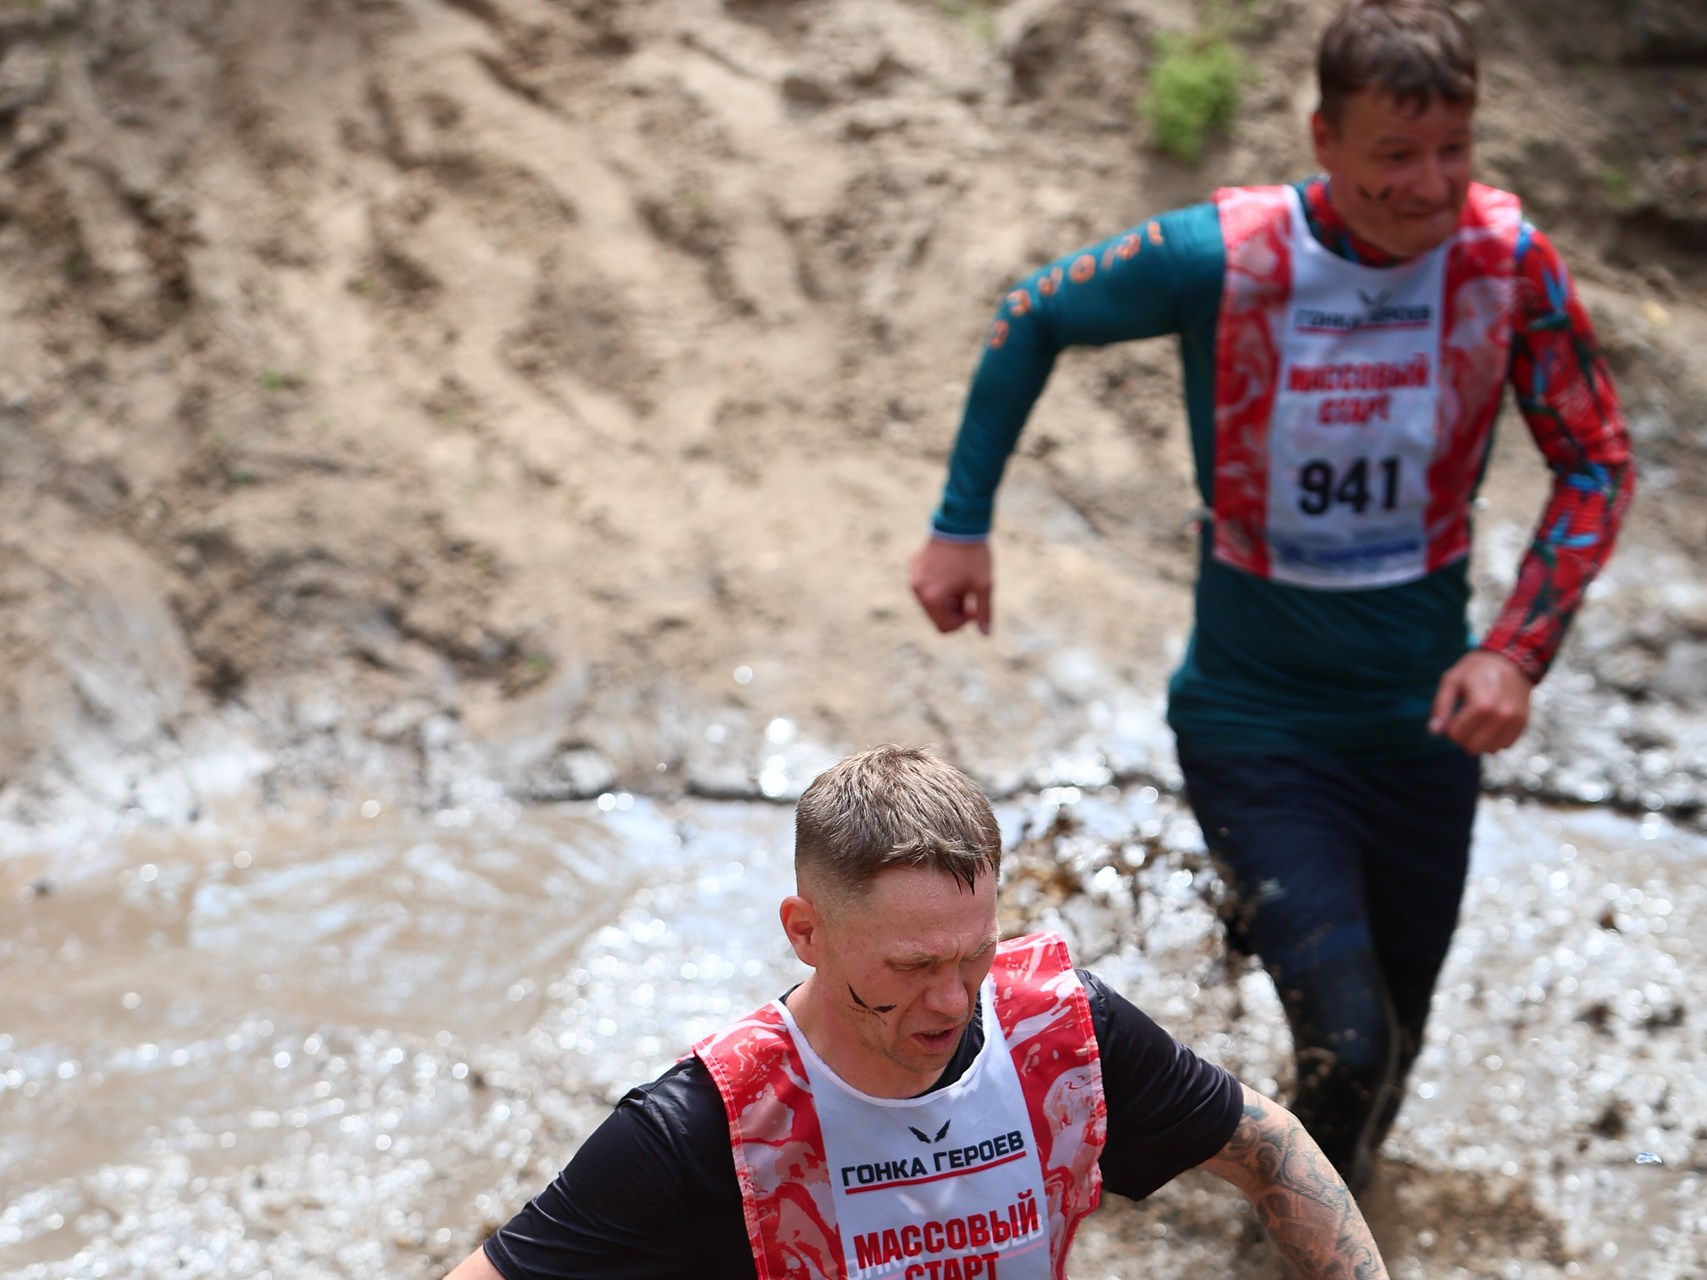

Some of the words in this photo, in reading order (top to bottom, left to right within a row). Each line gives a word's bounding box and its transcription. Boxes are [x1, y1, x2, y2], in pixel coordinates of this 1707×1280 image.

[1298, 455, 1401, 516] 941
[841, 1156, 928, 1187] ГОНКА
[932, 1130, 1025, 1173] ГЕРОЕВ
[853, 1188, 1039, 1270] МАССОВЫЙ
